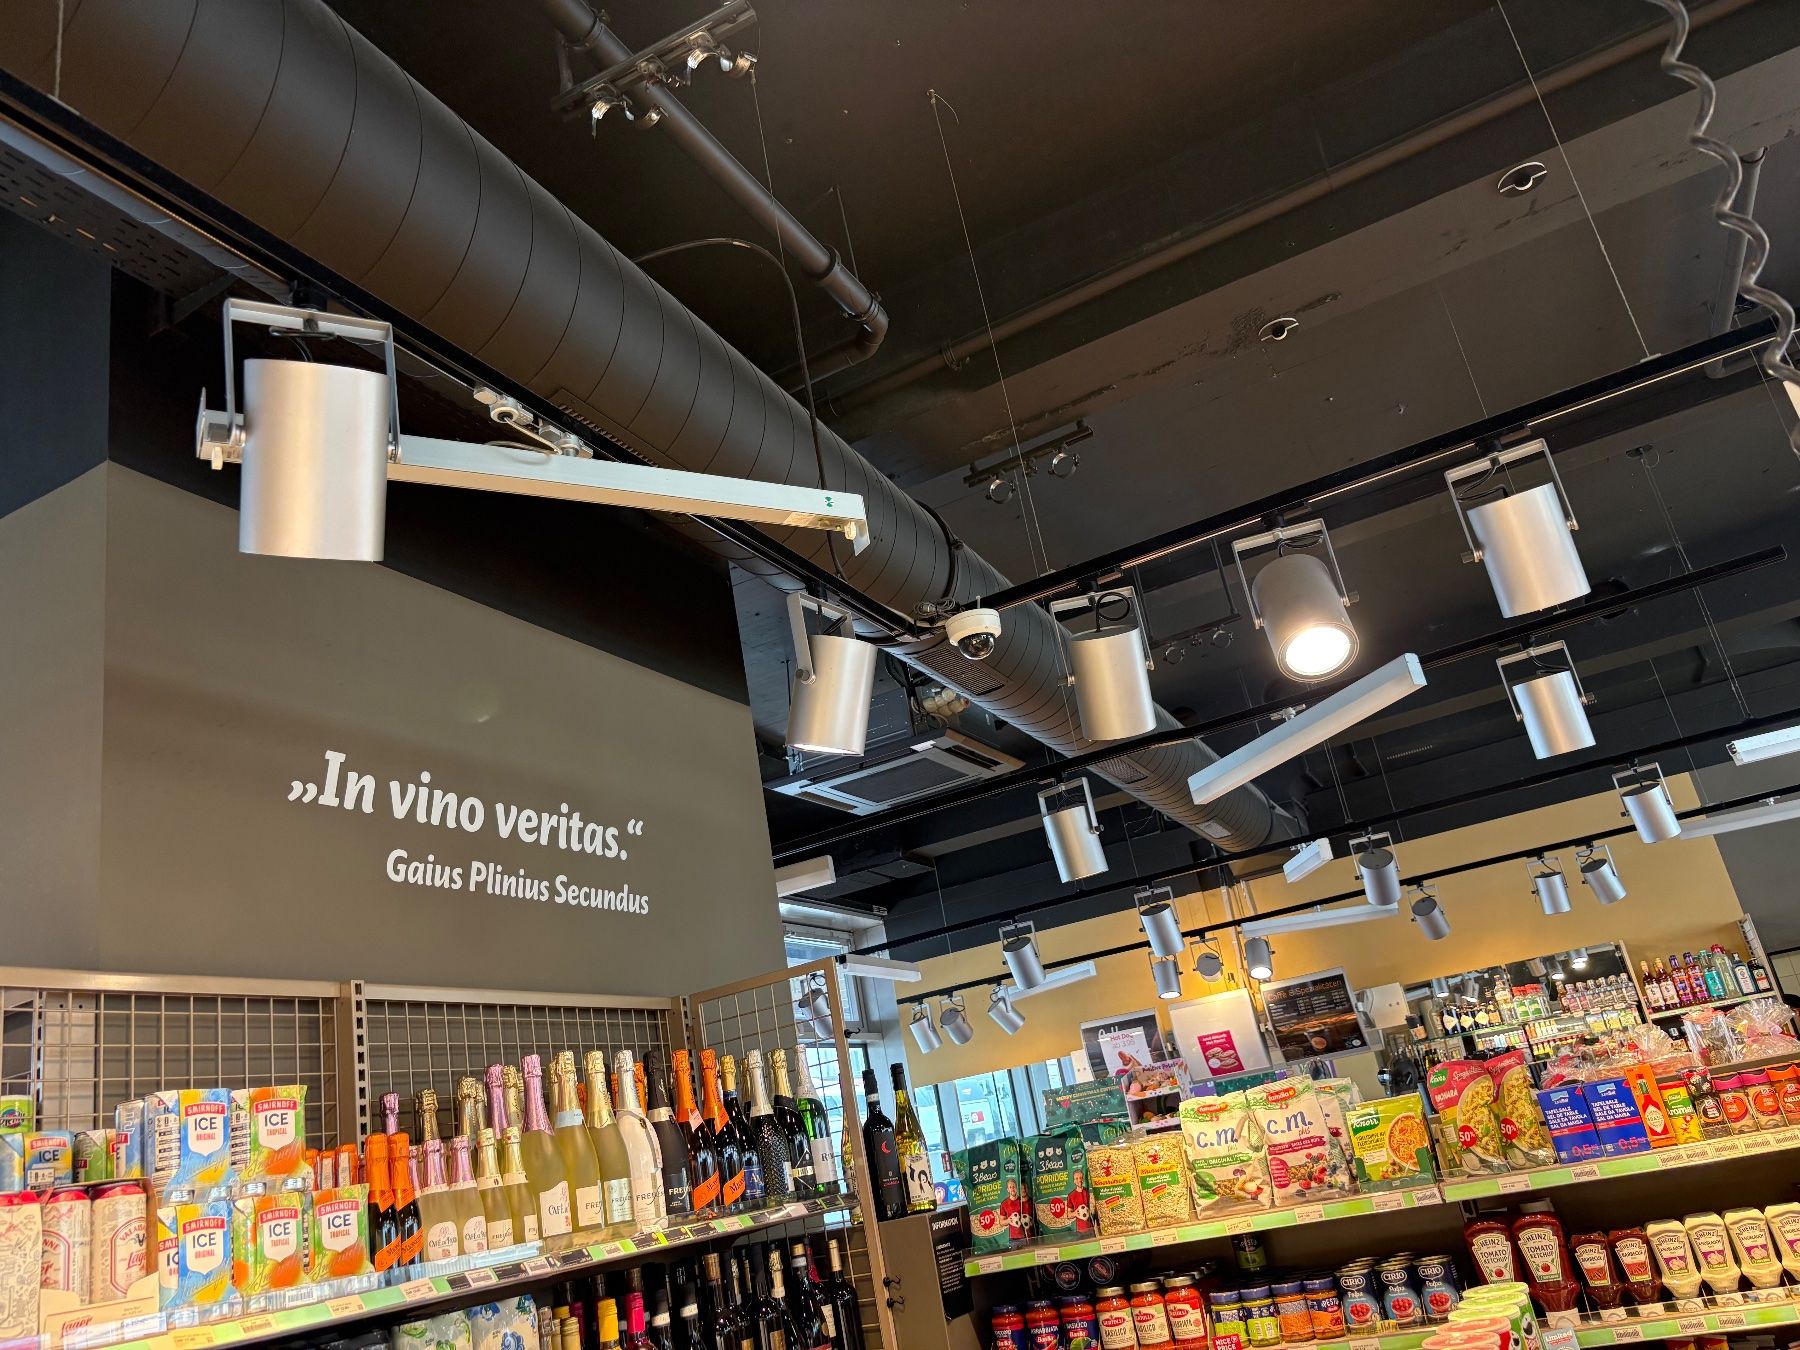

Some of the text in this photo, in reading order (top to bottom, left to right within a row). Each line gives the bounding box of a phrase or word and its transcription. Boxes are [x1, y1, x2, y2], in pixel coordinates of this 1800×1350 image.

[288, 750, 643, 861] „In vino veritas.“
[386, 849, 649, 914] Gaius Plinius Secundus
[1430, 1073, 1446, 1084] Knorr
[1268, 1091, 1289, 1101] familia
[258, 1100, 294, 1112] SMIRNOFF
[1591, 1098, 1618, 1107] TAFELSALZ
[1610, 1102, 1626, 1110] TABLE
[187, 1104, 224, 1115] SMIRNOFF
[1545, 1106, 1571, 1115] TAFELSALZ
[1614, 1106, 1634, 1114] TAVOLA
[264, 1113, 289, 1127] ICE
[1351, 1118, 1380, 1128] Knorr
[1568, 1114, 1588, 1122] TAVOLA
[194, 1116, 218, 1131] ICE
[266, 1128, 288, 1136] TROPICAL
[1500, 1124, 1517, 1134] 50%
[1460, 1132, 1476, 1142] 50%
[31, 1138, 66, 1150] SMIRNOFF
[38, 1150, 60, 1163] ICE
[1036, 1172, 1069, 1185] PORRIDGE
[320, 1202, 357, 1214] SMIRNOFF
[1050, 1202, 1066, 1213] 50%
[262, 1210, 296, 1222] SMIRNOFF
[980, 1214, 995, 1226] 50%
[185, 1219, 222, 1231] SMIRNOFF
[327, 1214, 352, 1230] ICE
[1784, 1218, 1800, 1226] HEINZ
[268, 1222, 291, 1238] ICE
[330, 1230, 350, 1239] TROPICAL
[192, 1232, 217, 1248] ICE
[1526, 1232, 1547, 1242] HEINZ
[1480, 1238, 1501, 1248] HEINZ
[1623, 1242, 1638, 1250] HEINZ
[1480, 1249, 1506, 1258] TOMATO
[1526, 1244, 1554, 1254] TOMATO
[1484, 1256, 1508, 1265] KETCHUP
[1530, 1251, 1554, 1260] KETCHUP
[1383, 1272, 1404, 1280] CIRIO
[1420, 1266, 1441, 1276] CIRIO
[1342, 1278, 1363, 1286] CIRIO
[1104, 1327, 1127, 1338] BASILICO
[1545, 1330, 1573, 1341] Limited
[1215, 1338, 1230, 1346] NICE
